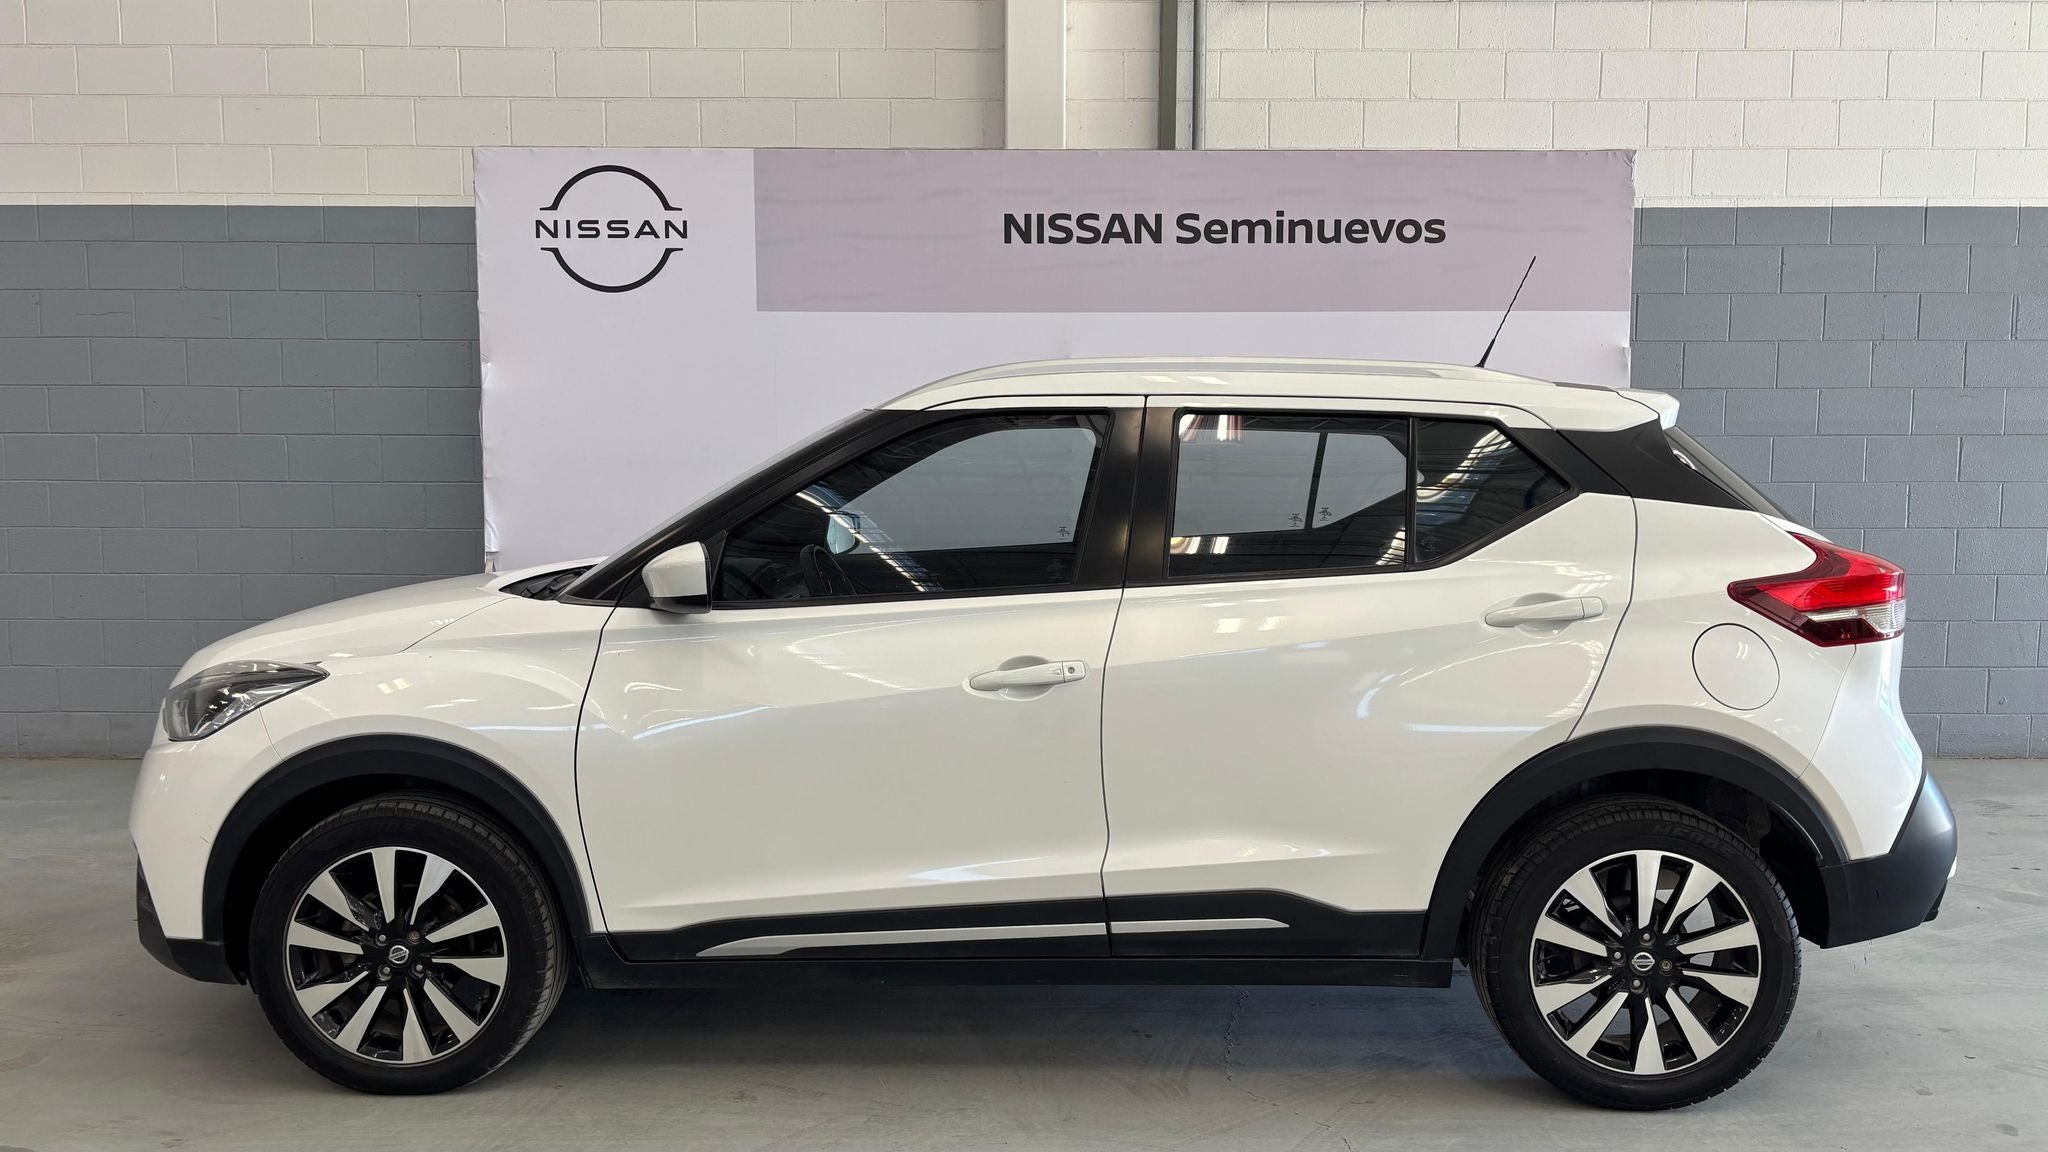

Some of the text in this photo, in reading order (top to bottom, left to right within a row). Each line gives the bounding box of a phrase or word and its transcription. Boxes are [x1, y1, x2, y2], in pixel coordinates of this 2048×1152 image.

[535, 219, 688, 239] NISSAN
[1003, 210, 1447, 245] NISSAN Seminuevos
